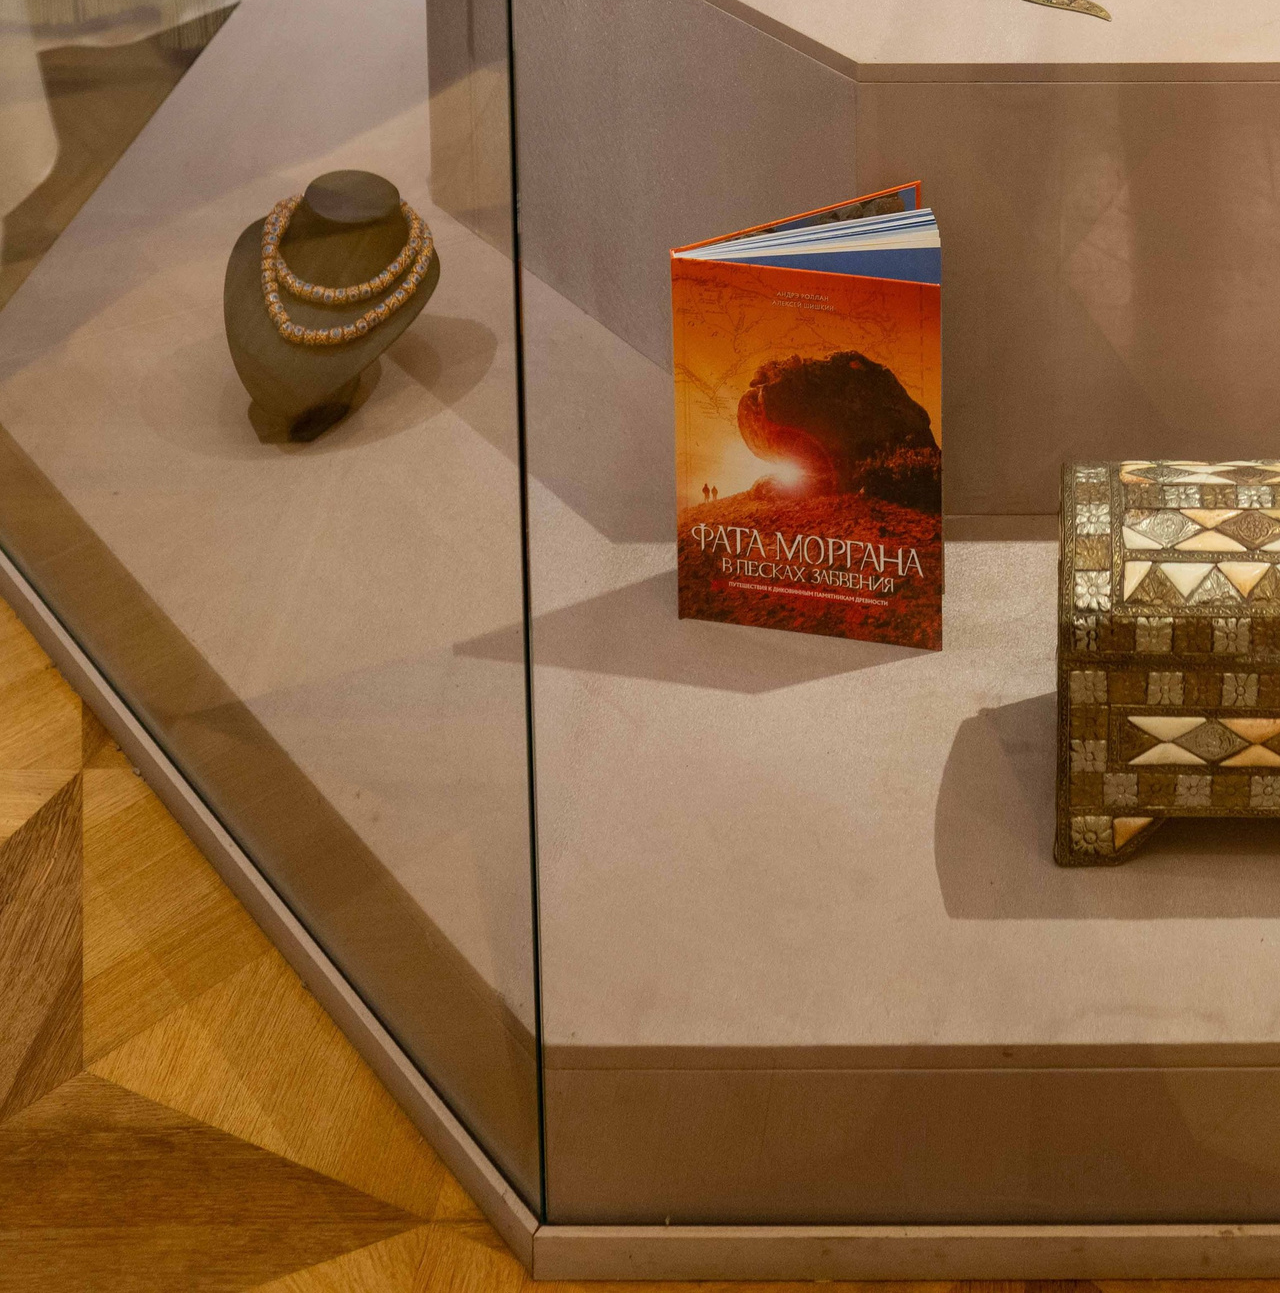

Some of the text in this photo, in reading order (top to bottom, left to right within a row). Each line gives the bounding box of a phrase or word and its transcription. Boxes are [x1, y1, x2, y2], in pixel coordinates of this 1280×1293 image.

[771, 300, 835, 312] АЛЕКСЕЙ ШИШКИН
[691, 523, 924, 578] ФАТА-МОРГАНА
[722, 557, 895, 593] В ПЕСКАХ ЗАБВЕНИЯ
[728, 581, 768, 592] ПУТЕШЕСТВИЯ
[773, 587, 814, 598] ДИКОВИННЫМ
[814, 592, 855, 602] ПАМЯТНИКАМ
[855, 596, 889, 607] ДРЕВНОСТИ
